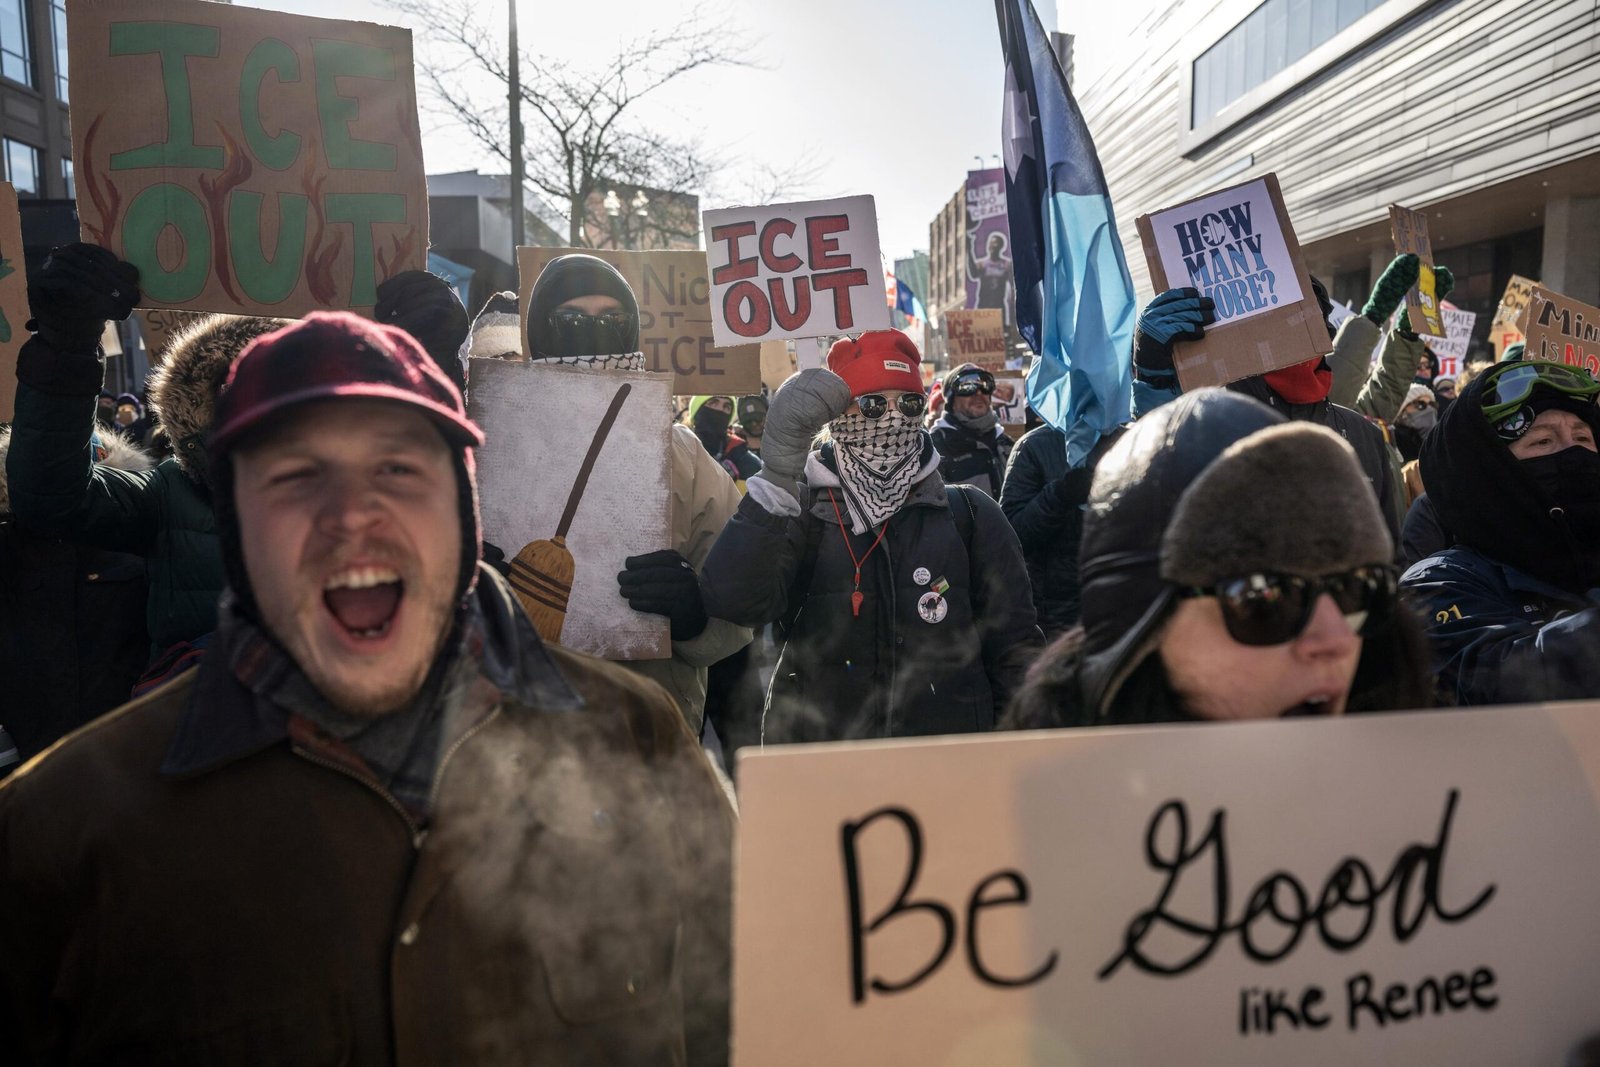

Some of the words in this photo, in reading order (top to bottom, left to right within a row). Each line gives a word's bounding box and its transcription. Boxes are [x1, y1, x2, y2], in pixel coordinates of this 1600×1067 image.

[110, 21, 397, 171] ICE
[122, 183, 407, 307] OUT
[712, 213, 852, 286] ICE
[1173, 201, 1253, 257] HOW
[1183, 233, 1268, 288] MANY
[642, 263, 709, 306] Nic
[723, 267, 869, 338] OUT
[639, 310, 685, 330] OT
[947, 319, 974, 339] ICE
[645, 335, 725, 376] ICE
[840, 804, 1059, 1006] Be
[1097, 787, 1498, 982] Good
[1239, 980, 1332, 1036] like
[1347, 964, 1501, 1031] Renee
